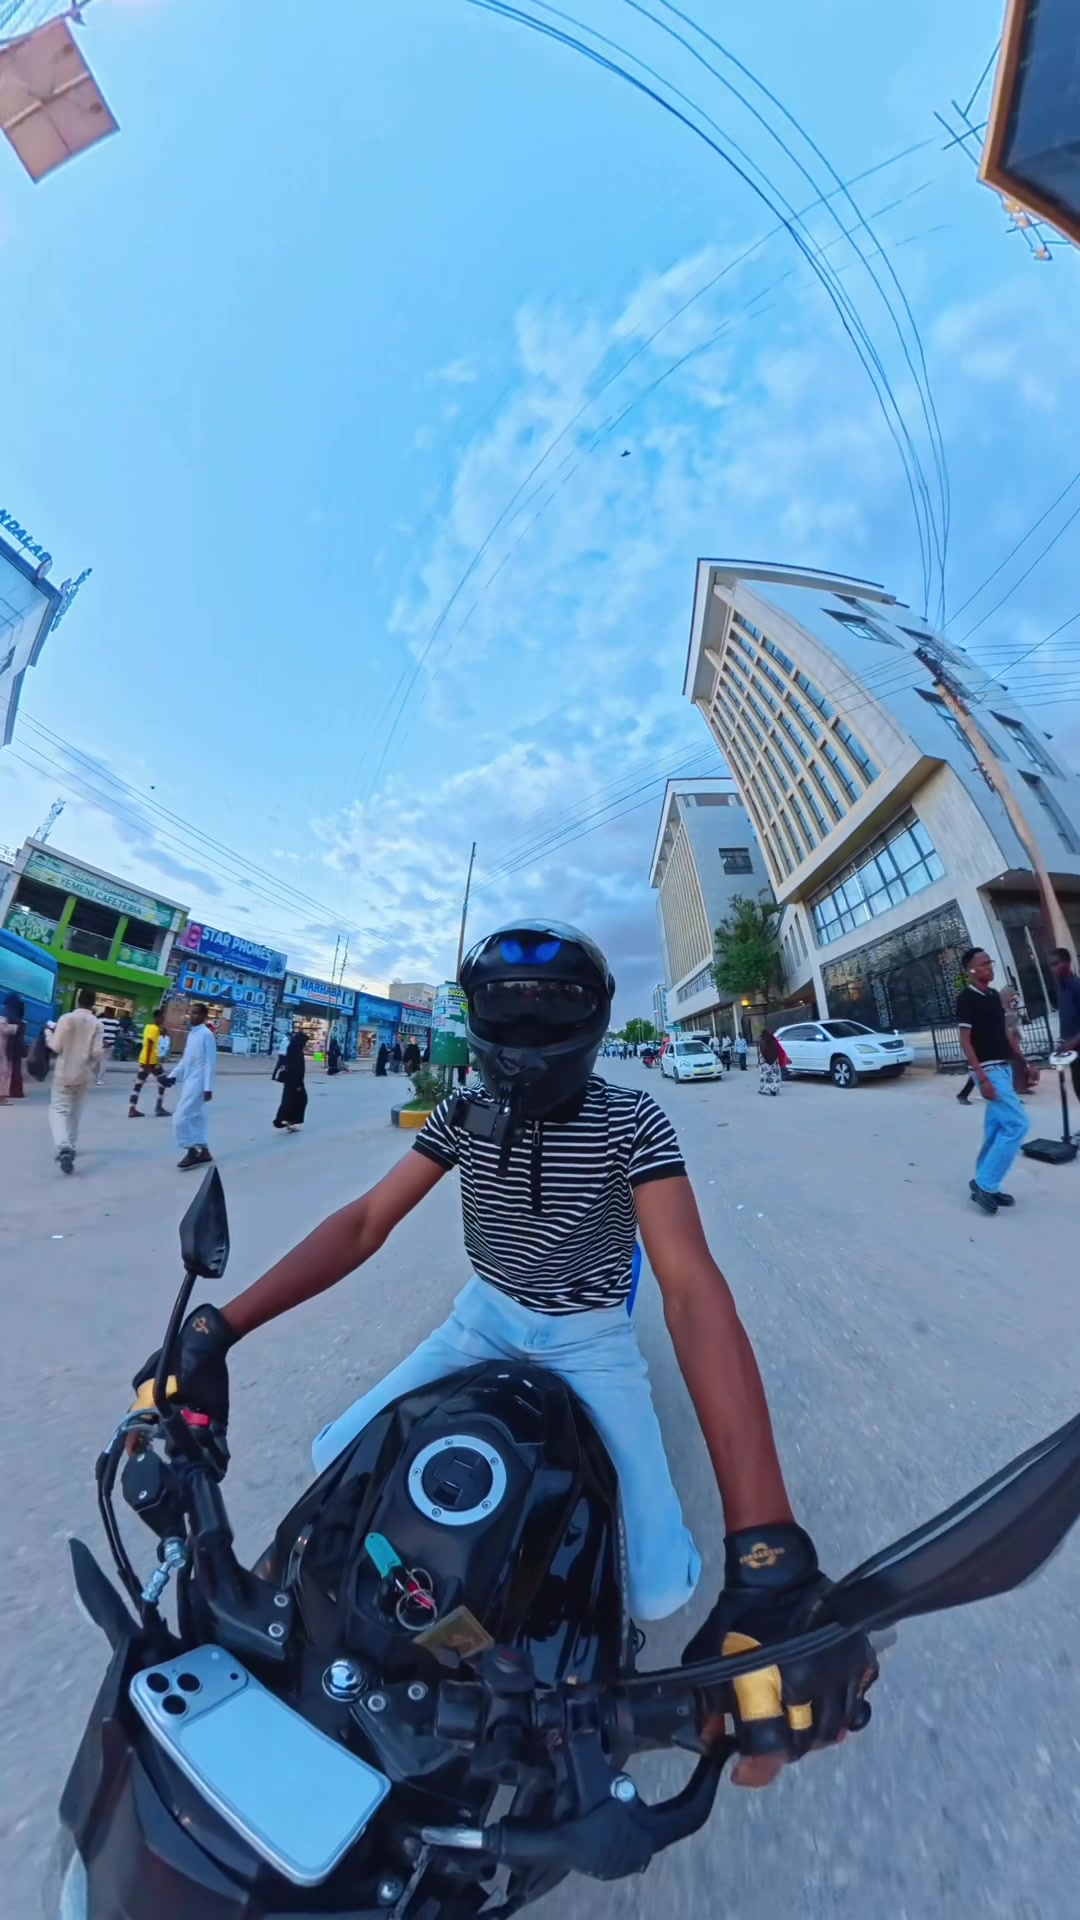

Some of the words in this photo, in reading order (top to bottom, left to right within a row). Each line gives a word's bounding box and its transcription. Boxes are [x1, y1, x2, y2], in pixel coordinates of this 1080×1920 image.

[60, 875, 94, 897] YEMENI
[95, 891, 142, 915] CAFETERIA
[202, 926, 231, 948] STAR
[232, 937, 274, 961] PHONES
[300, 979, 342, 998] MARHABA
